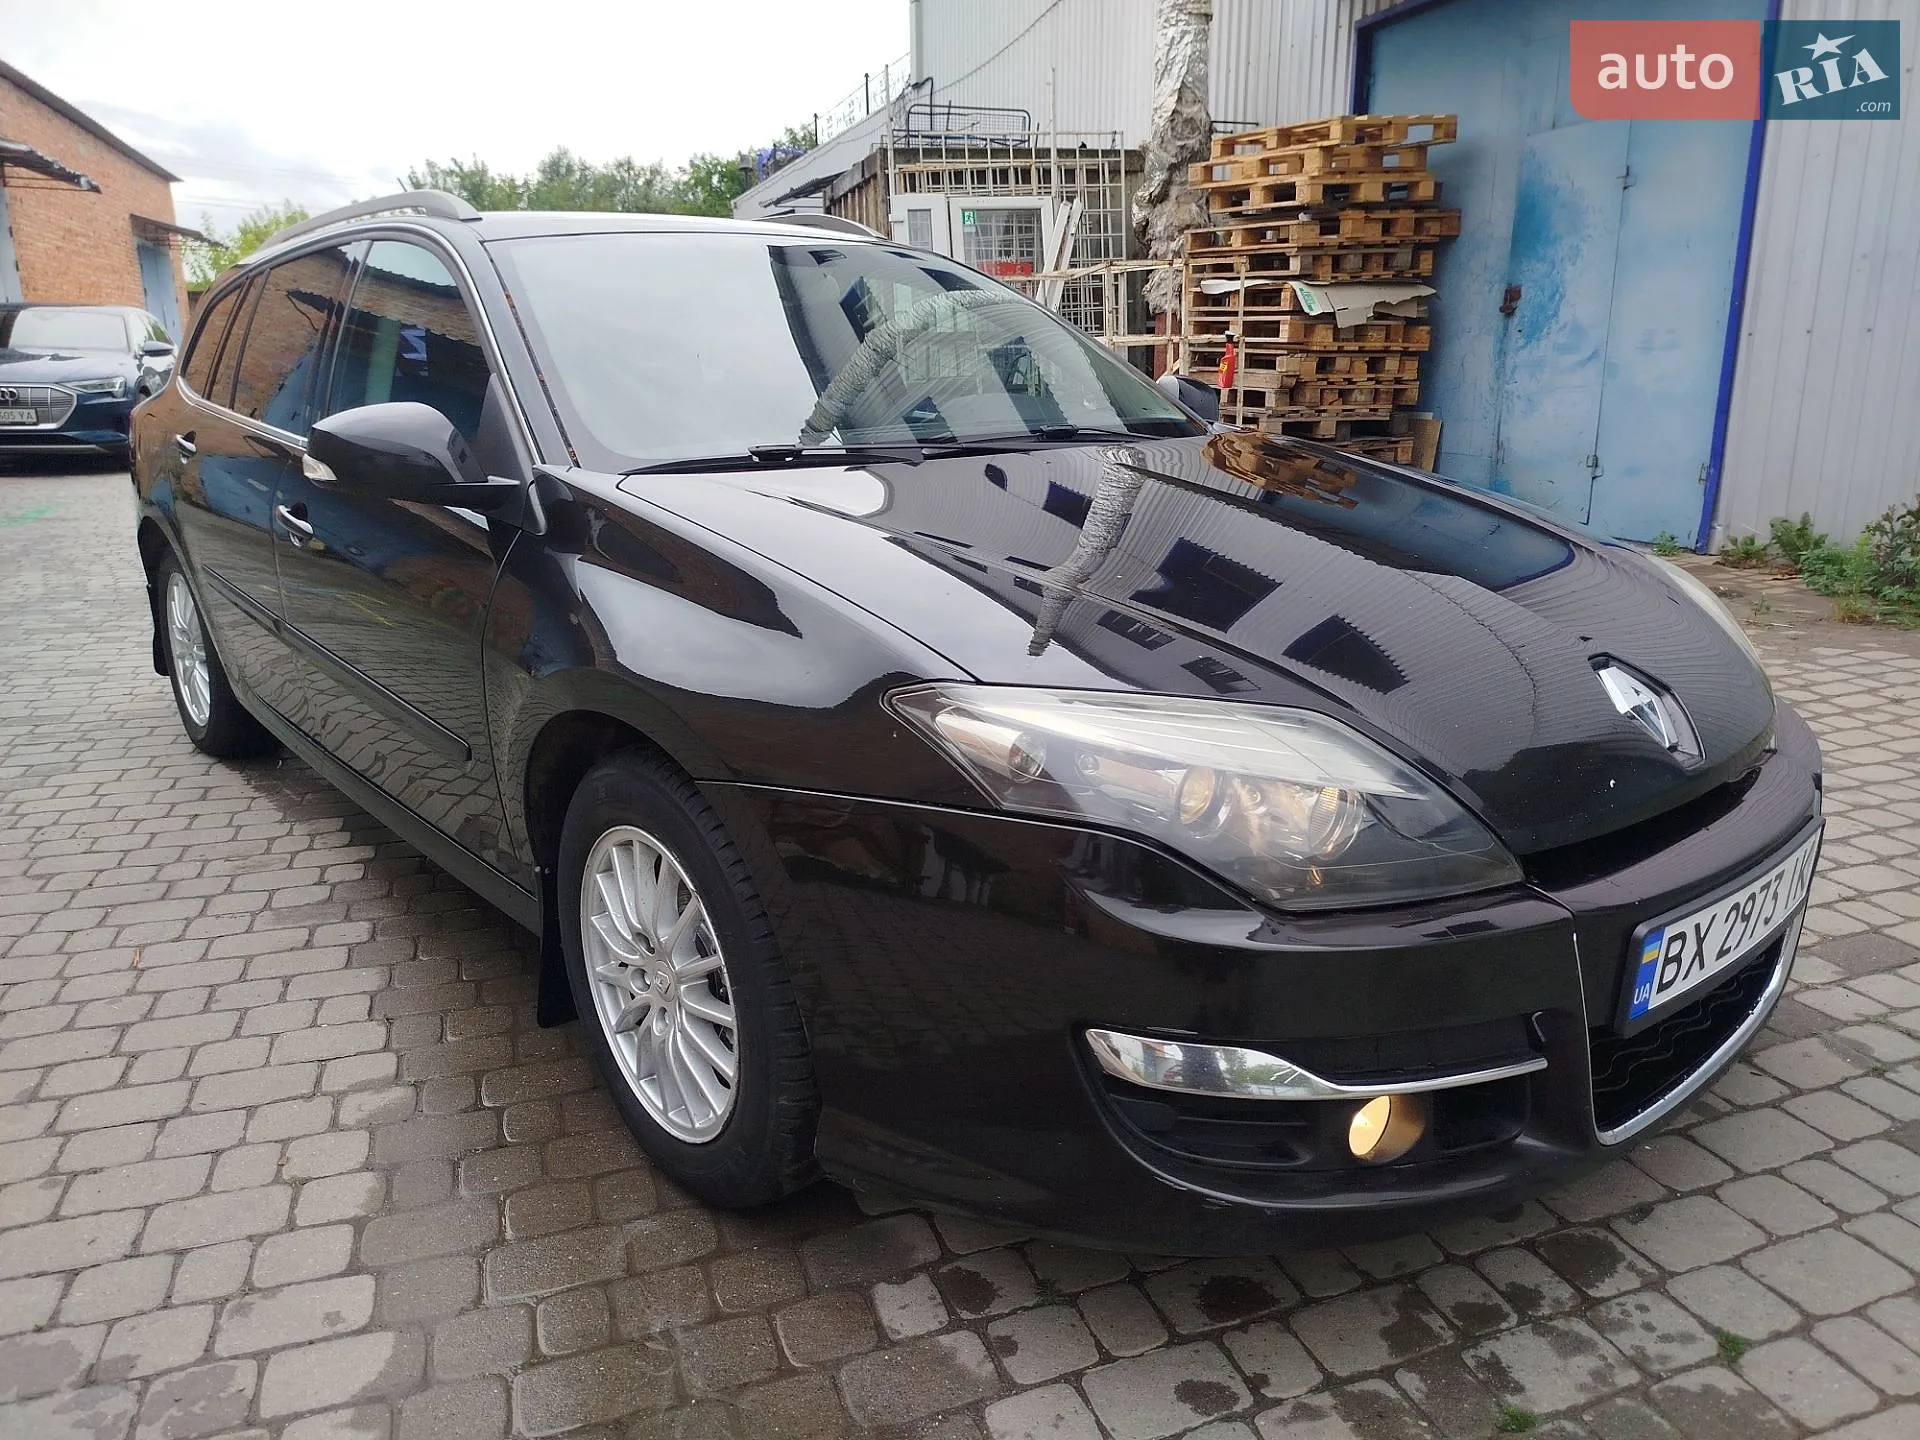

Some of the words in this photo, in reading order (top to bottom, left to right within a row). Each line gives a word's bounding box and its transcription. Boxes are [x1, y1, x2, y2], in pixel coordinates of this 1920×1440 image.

[1656, 912, 1718, 996] BX
[1714, 867, 1786, 962] 2973
[1784, 838, 1817, 910] IK
[1633, 985, 1650, 1006] UA
